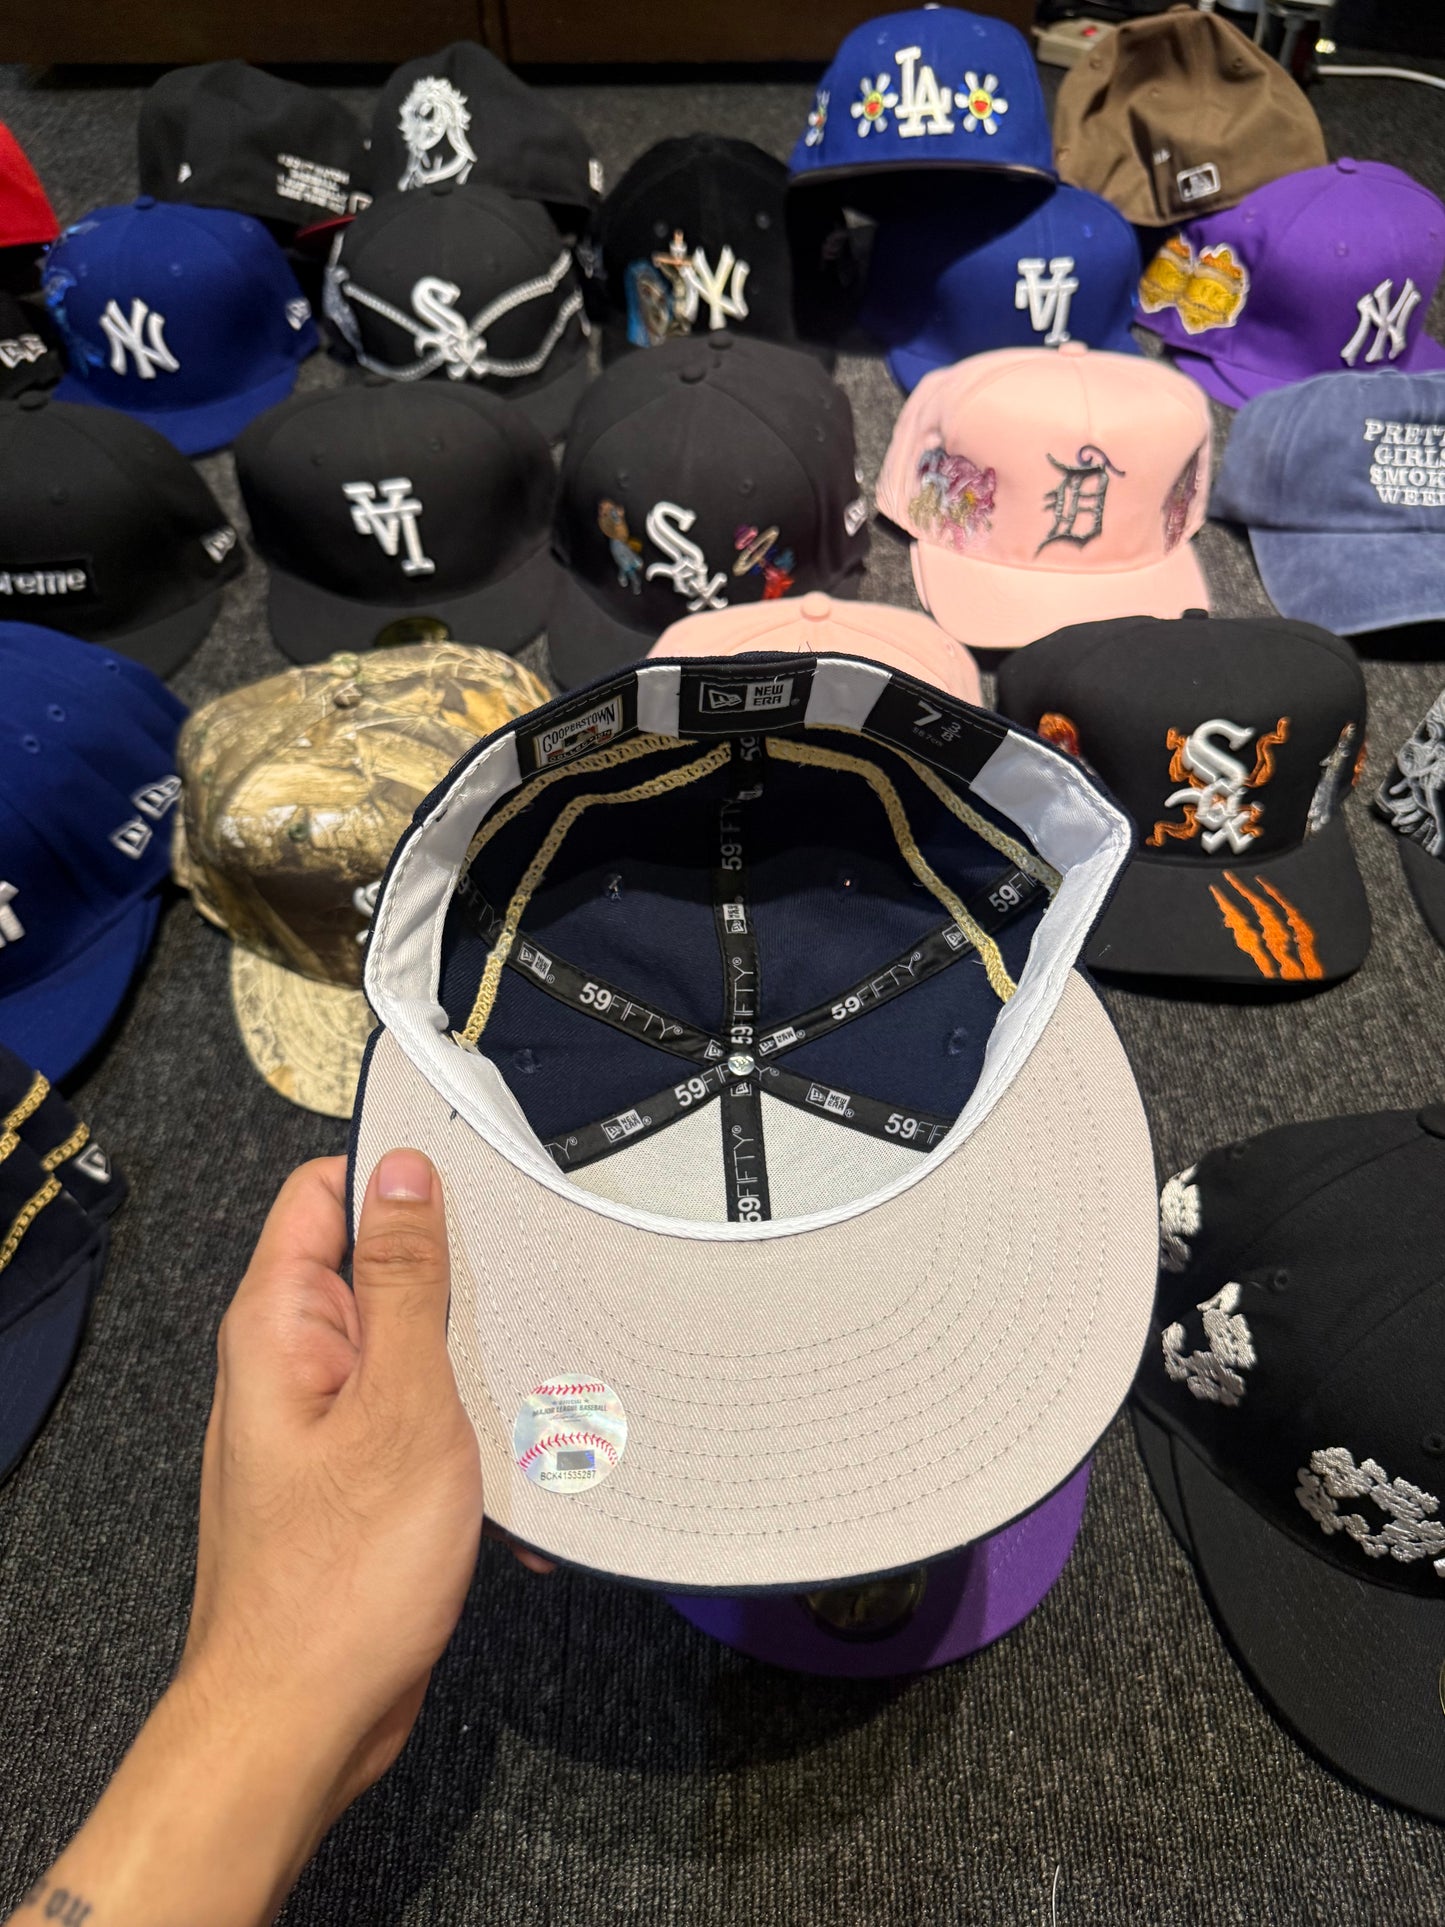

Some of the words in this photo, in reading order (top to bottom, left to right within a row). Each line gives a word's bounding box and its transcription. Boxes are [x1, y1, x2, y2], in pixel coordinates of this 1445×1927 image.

[895, 46, 955, 137] LA
[679, 244, 750, 331] NY
[1340, 278, 1421, 367] NY
[99, 298, 180, 379] NY
[645, 501, 728, 611] Sox
[542, 703, 615, 753] COOPERSTOWN
[753, 695, 782, 706] ERA
[754, 684, 784, 697] NEW
[913, 700, 943, 727] 7
[1164, 718, 1257, 855] Sox
[532, 1407, 555, 1417] MAJOR
[556, 1405, 578, 1413] LEAGUE
[579, 1404, 608, 1412] BASEBALL
